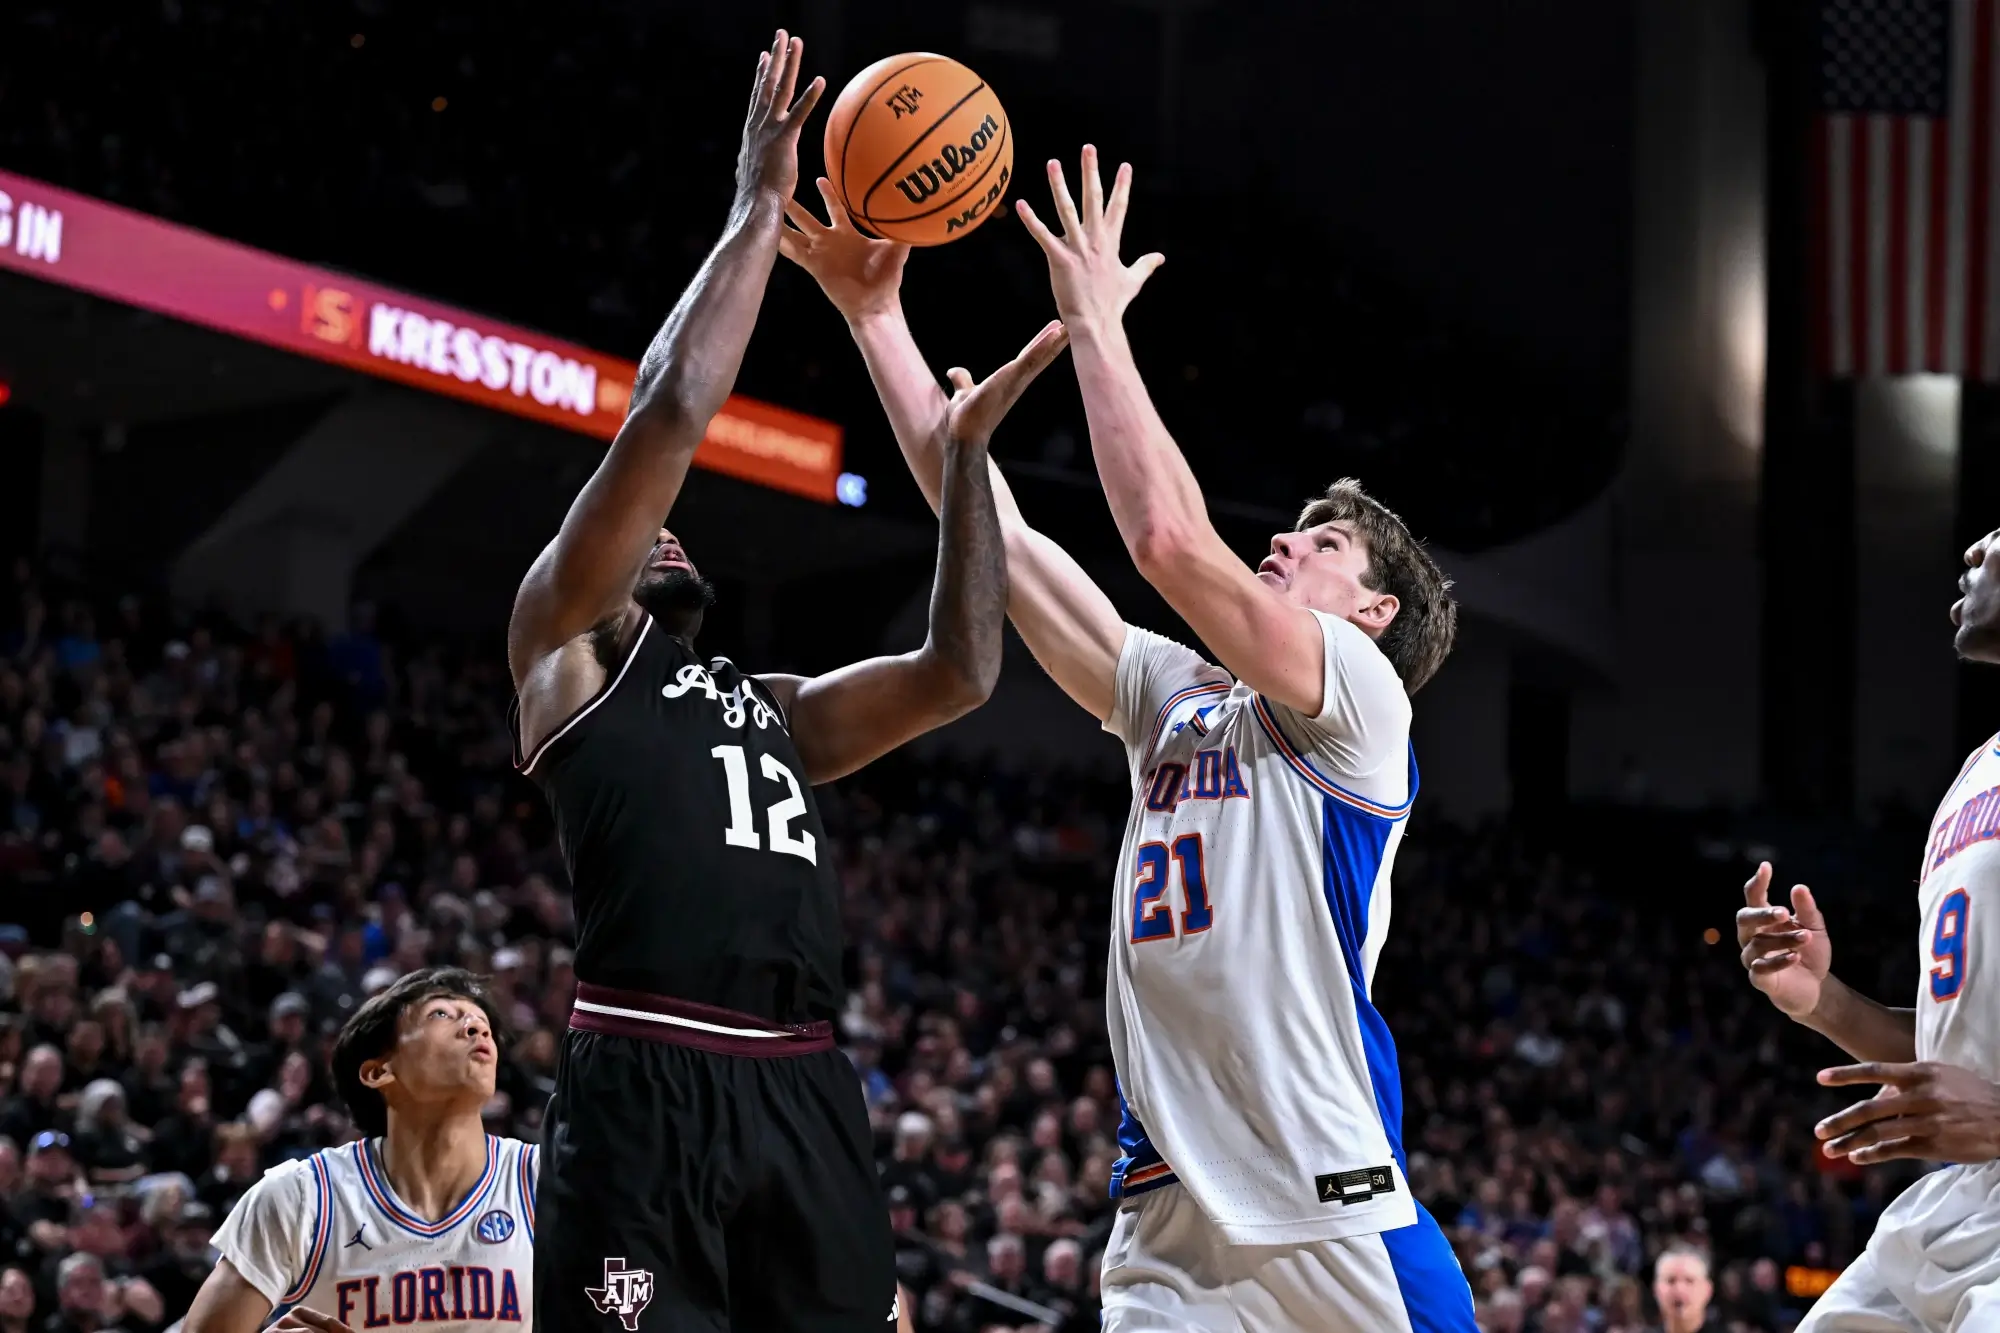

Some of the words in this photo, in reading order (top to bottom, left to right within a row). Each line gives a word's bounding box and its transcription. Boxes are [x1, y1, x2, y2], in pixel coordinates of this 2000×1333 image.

[895, 114, 999, 204] Wilson
[17, 201, 63, 264] IN
[946, 165, 1010, 233] NCAA
[369, 302, 597, 416] KRESSTON
[711, 744, 817, 867] 12
[1130, 832, 1214, 944] 21
[1929, 887, 1971, 1004] 9
[1372, 1174, 1386, 1186] 50
[479, 1211, 514, 1241] SEC
[336, 1265, 522, 1329] FLORIDA
